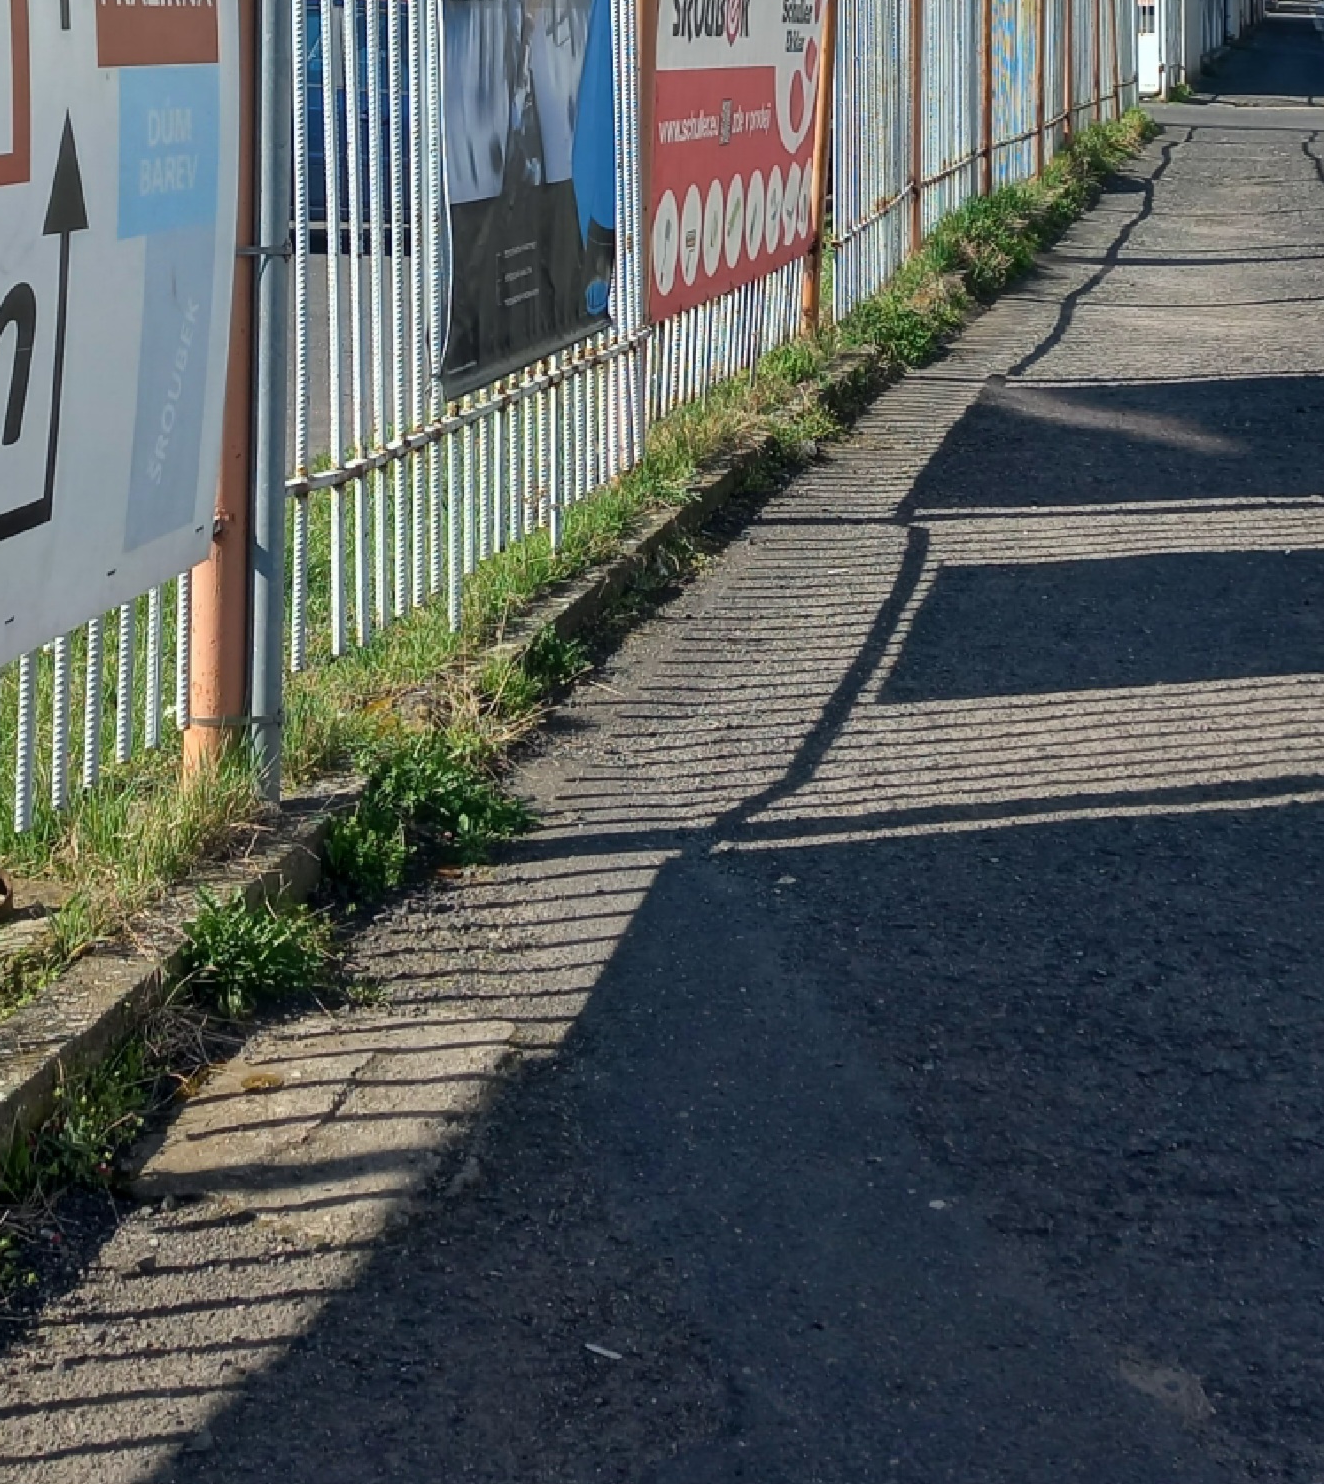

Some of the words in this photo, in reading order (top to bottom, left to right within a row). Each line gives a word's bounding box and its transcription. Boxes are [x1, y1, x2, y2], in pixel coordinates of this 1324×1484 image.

[147, 97, 193, 148] DŮM
[139, 154, 199, 197] BAREV
[147, 296, 200, 485] ŠROUBEK
